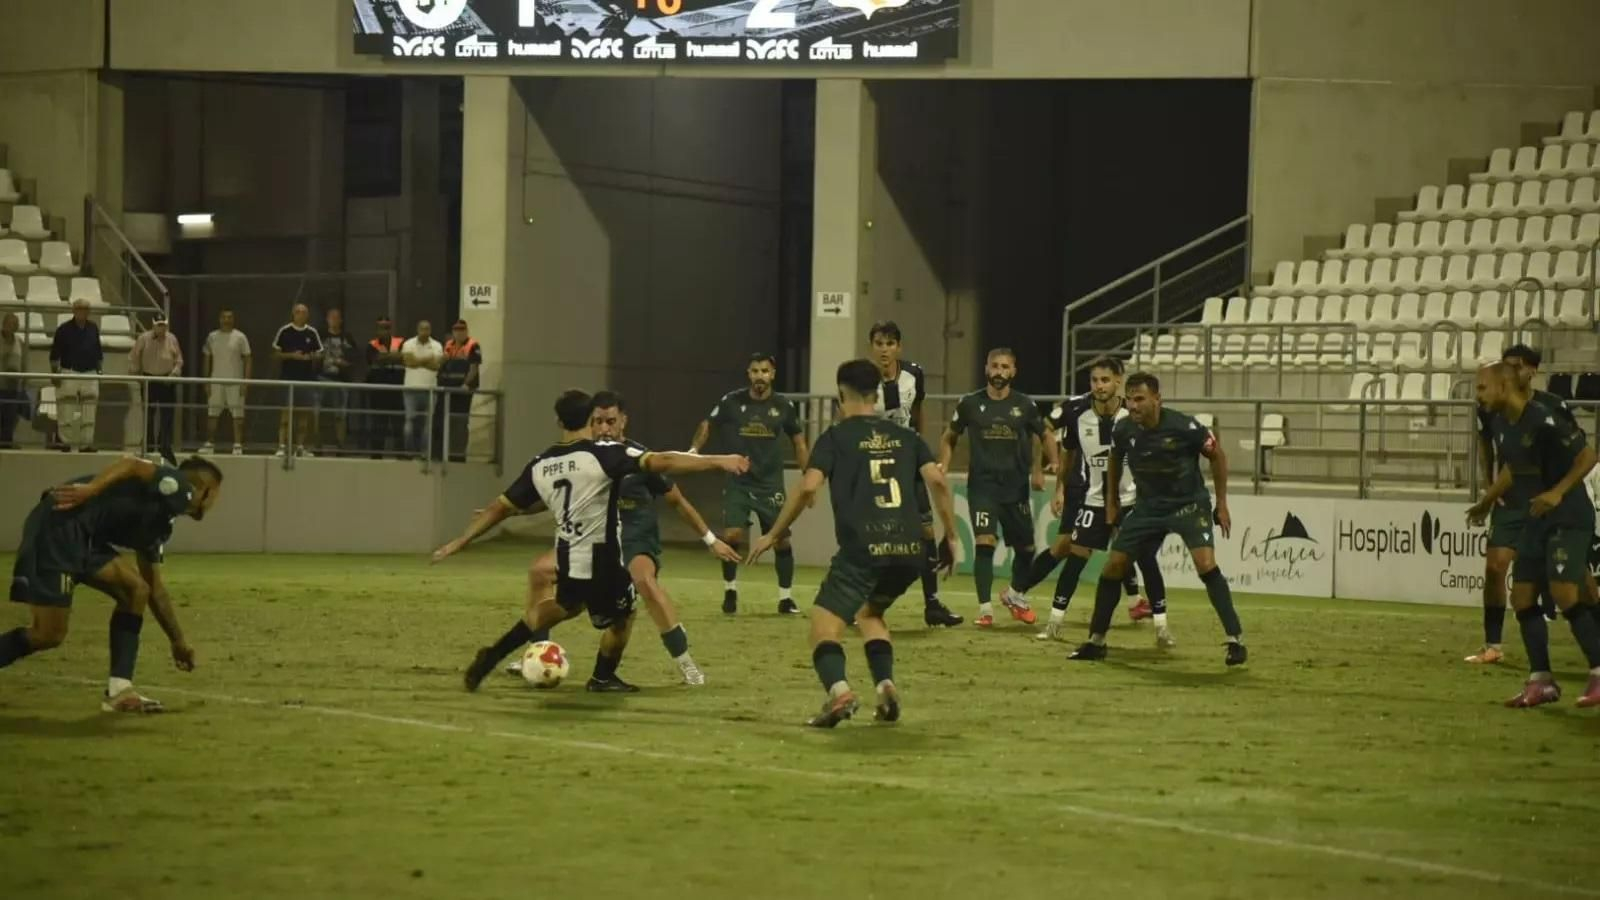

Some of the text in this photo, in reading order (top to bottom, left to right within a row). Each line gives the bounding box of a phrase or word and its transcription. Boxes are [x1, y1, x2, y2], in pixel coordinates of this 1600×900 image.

[469, 285, 491, 297] BAR
[822, 293, 844, 305] BAR
[543, 462, 564, 477] PEPE
[869, 458, 902, 508] 5
[553, 478, 573, 522] 7
[975, 511, 989, 528] 15
[1075, 509, 1095, 529] 20
[1339, 519, 1416, 560] Hospital
[1440, 569, 1485, 594] Campo
